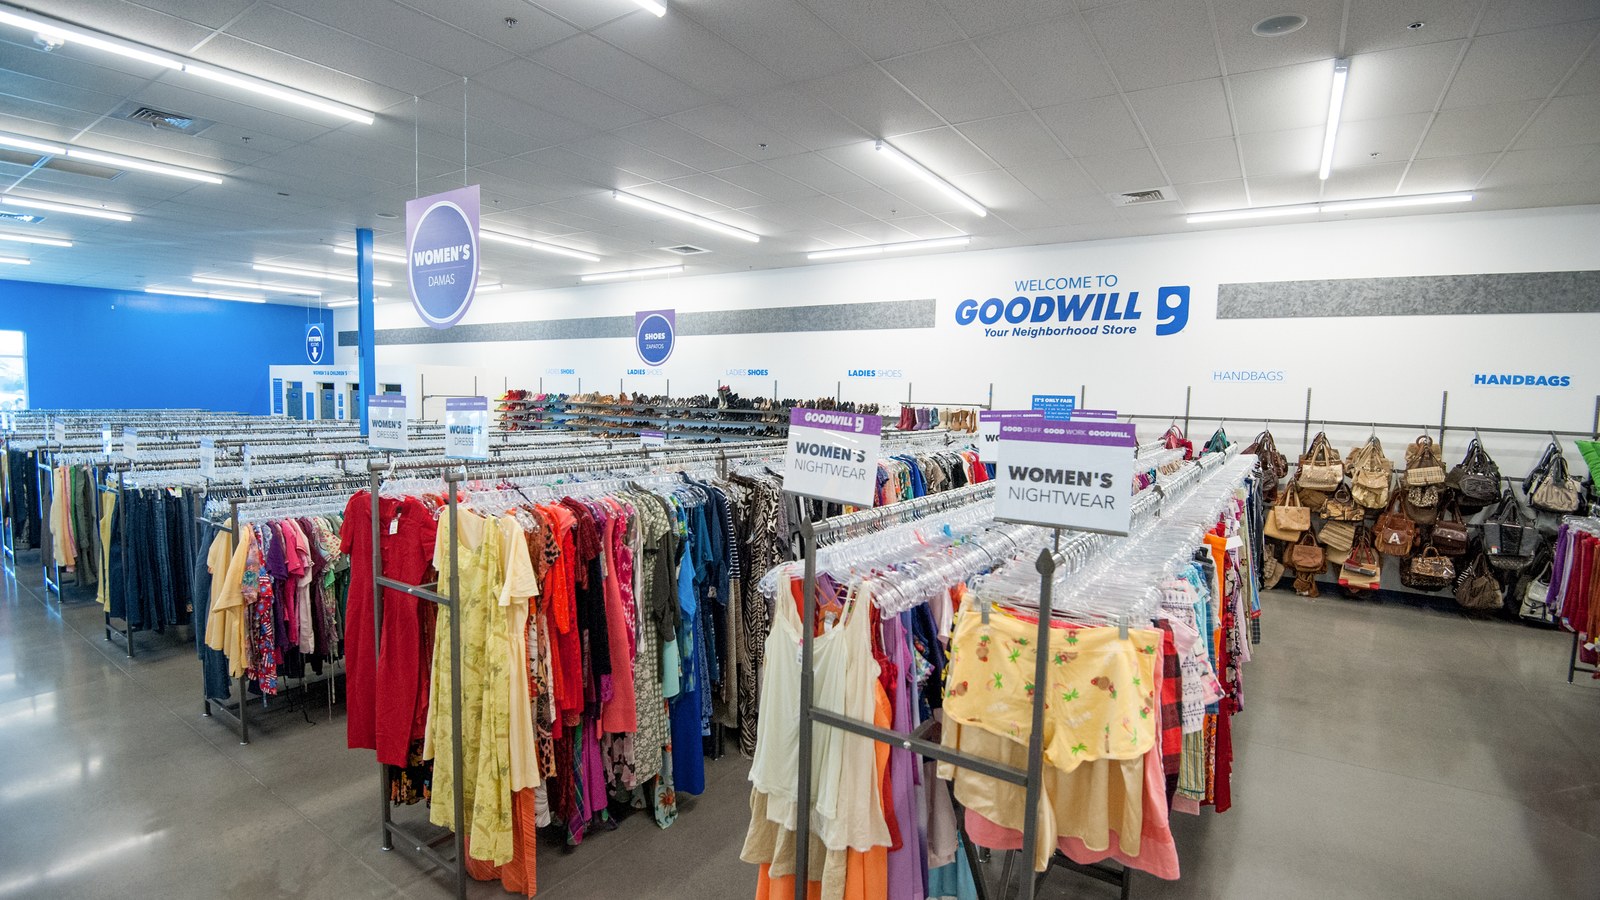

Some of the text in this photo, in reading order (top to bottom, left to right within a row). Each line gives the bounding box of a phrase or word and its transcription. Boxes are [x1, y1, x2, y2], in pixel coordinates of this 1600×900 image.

[414, 243, 471, 267] WOMEN'S
[428, 273, 456, 287] DAMAS
[1014, 274, 1118, 292] WELCOME TO
[955, 291, 1142, 326] GOODWILL
[644, 332, 666, 340] SHOES
[984, 324, 1137, 339] Your Neighborhood Store
[848, 369, 902, 378] LADIES SHOES
[1213, 371, 1284, 381] HANDBAGS
[1474, 374, 1570, 387] HANDBAGS
[371, 419, 402, 429] WOMEN'S
[804, 412, 853, 427] GOODWILL
[376, 430, 399, 440] DRESSES
[1002, 425, 1023, 433] GOOD
[796, 441, 866, 463] WOMEN'S
[794, 458, 866, 481] NIGHTWEAR
[1008, 465, 1113, 489] WOMEN'S
[1008, 486, 1116, 510] NIGHTWEAR
[1388, 532, 1401, 545] A
